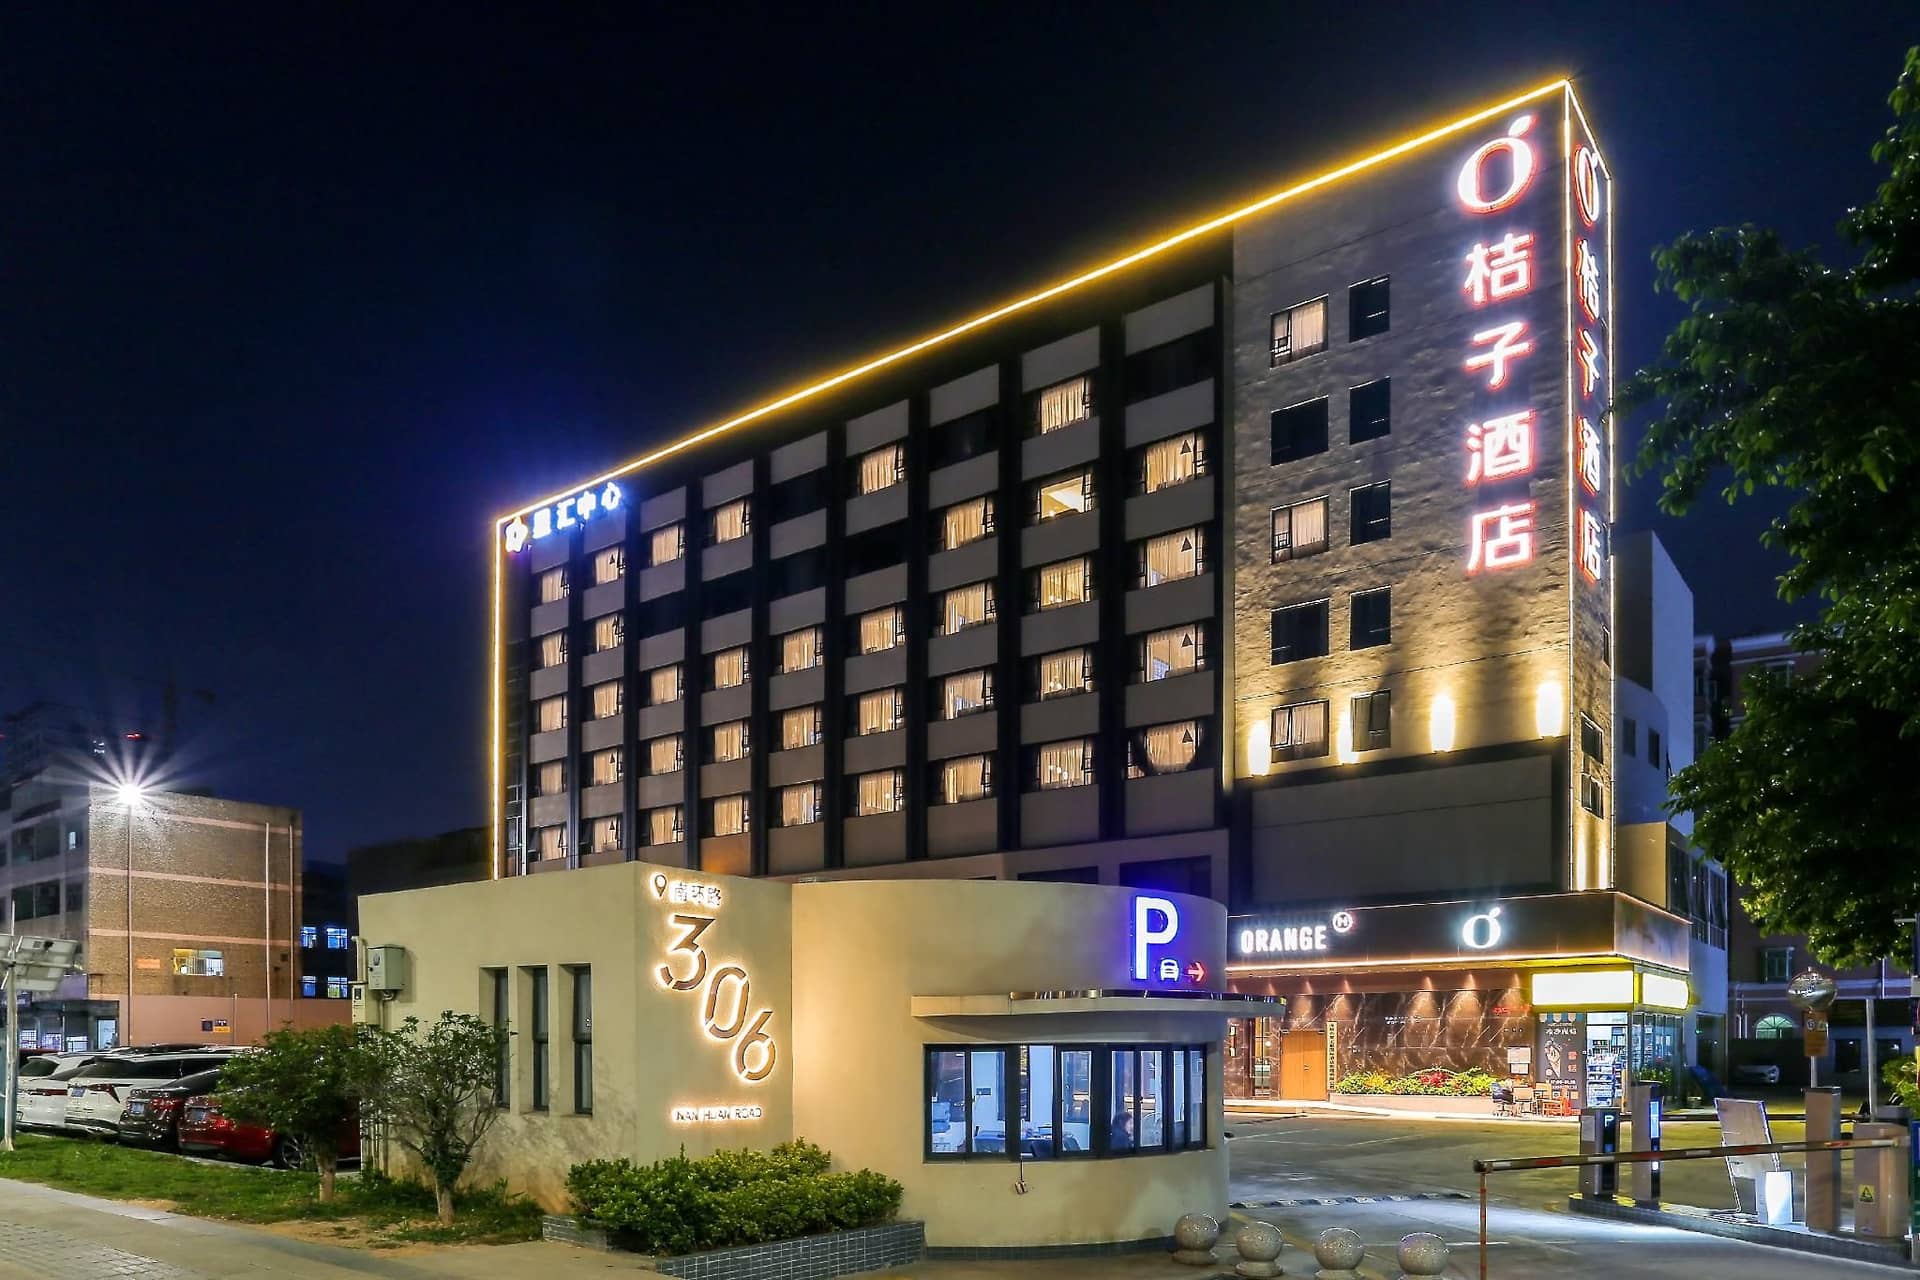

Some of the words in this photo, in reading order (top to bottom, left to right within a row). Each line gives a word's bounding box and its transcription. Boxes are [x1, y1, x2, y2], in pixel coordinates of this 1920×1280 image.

[1464, 232, 1535, 576] 桔子酒店
[1135, 896, 1179, 980] P
[1240, 925, 1327, 954] ORANGE
[659, 914, 777, 1081] 306
[675, 1110, 699, 1121] NAN
[735, 1106, 763, 1119] ROAD
[1604, 1114, 1615, 1128] P
